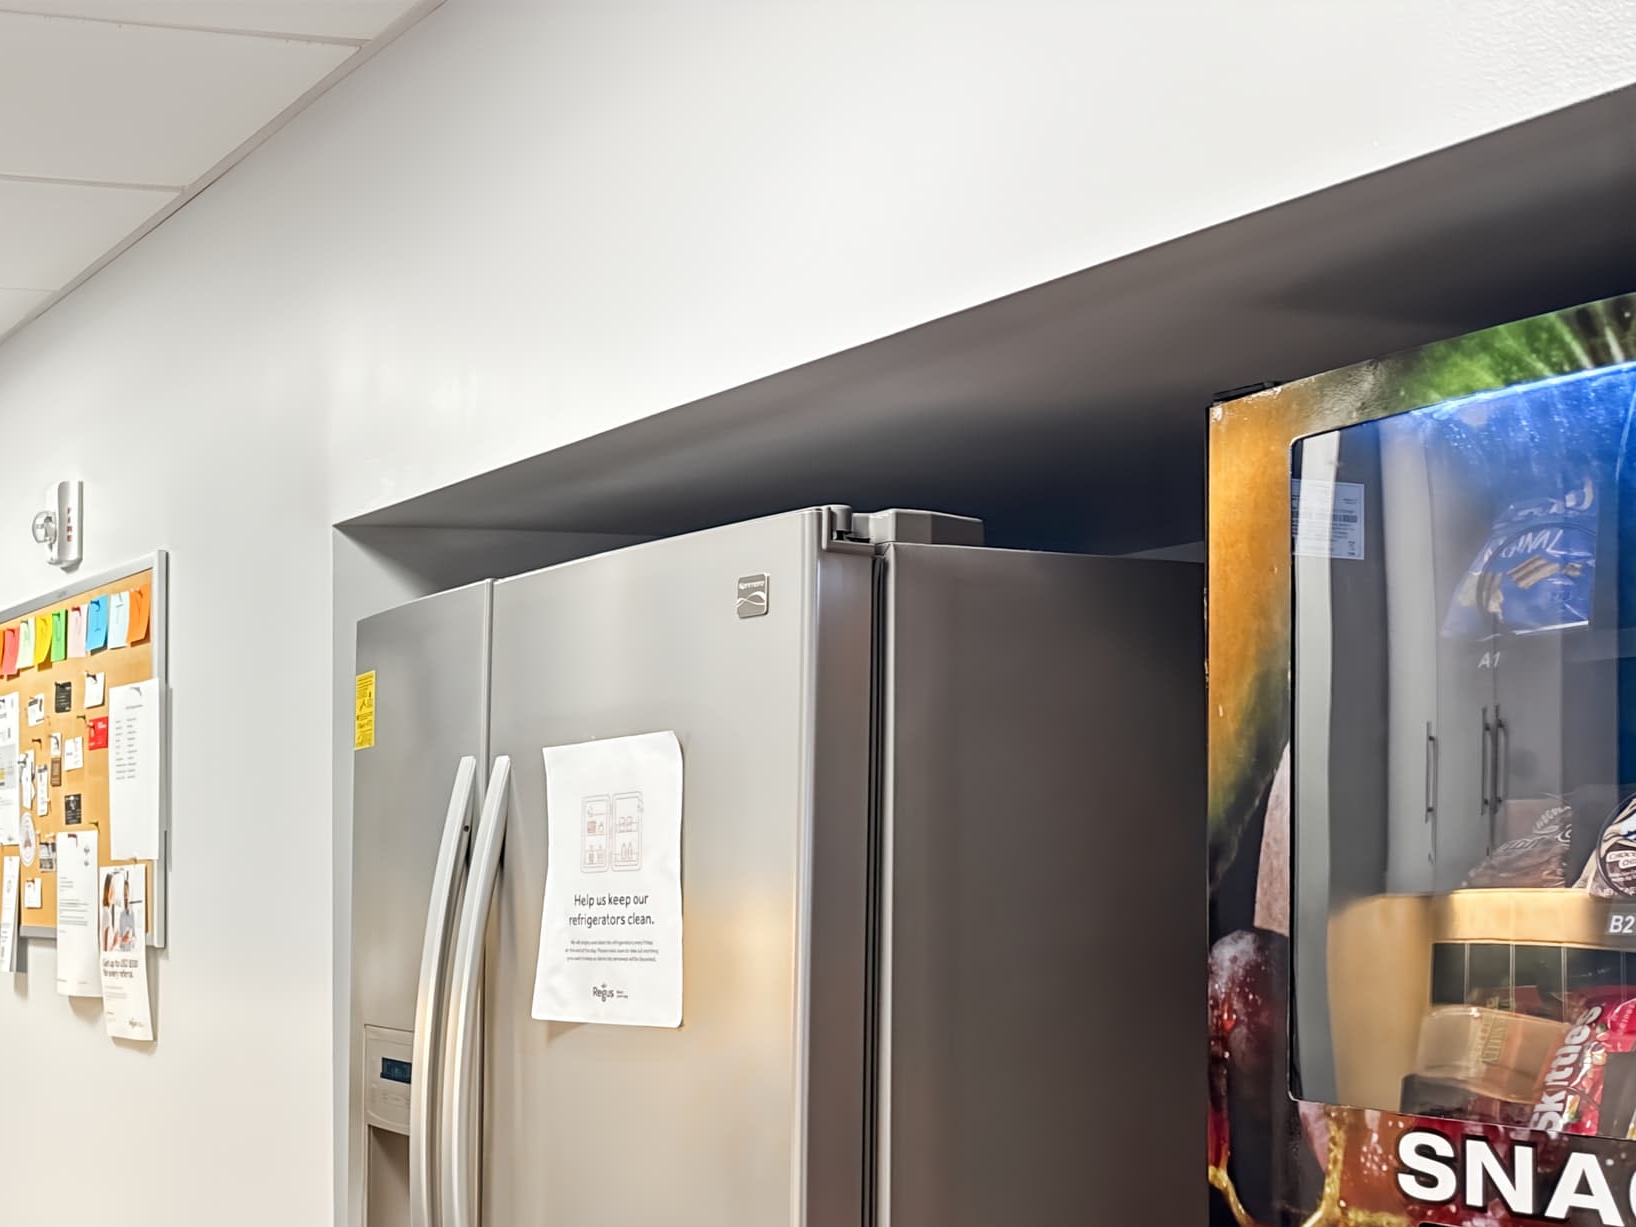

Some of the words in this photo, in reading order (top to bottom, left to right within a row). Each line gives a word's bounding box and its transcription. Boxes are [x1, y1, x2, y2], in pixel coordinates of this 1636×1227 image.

[1478, 651, 1500, 668] A1
[574, 893, 595, 909] Help
[596, 896, 607, 906] us
[608, 892, 631, 908] keep
[633, 895, 649, 905] our
[569, 913, 626, 929] refrigerators
[627, 912, 655, 926] clean.
[1608, 914, 1635, 934] B2
[593, 984, 614, 1002] Regus
[1531, 1006, 1604, 1133] Skittles
[1397, 1131, 1636, 1227] SNA
